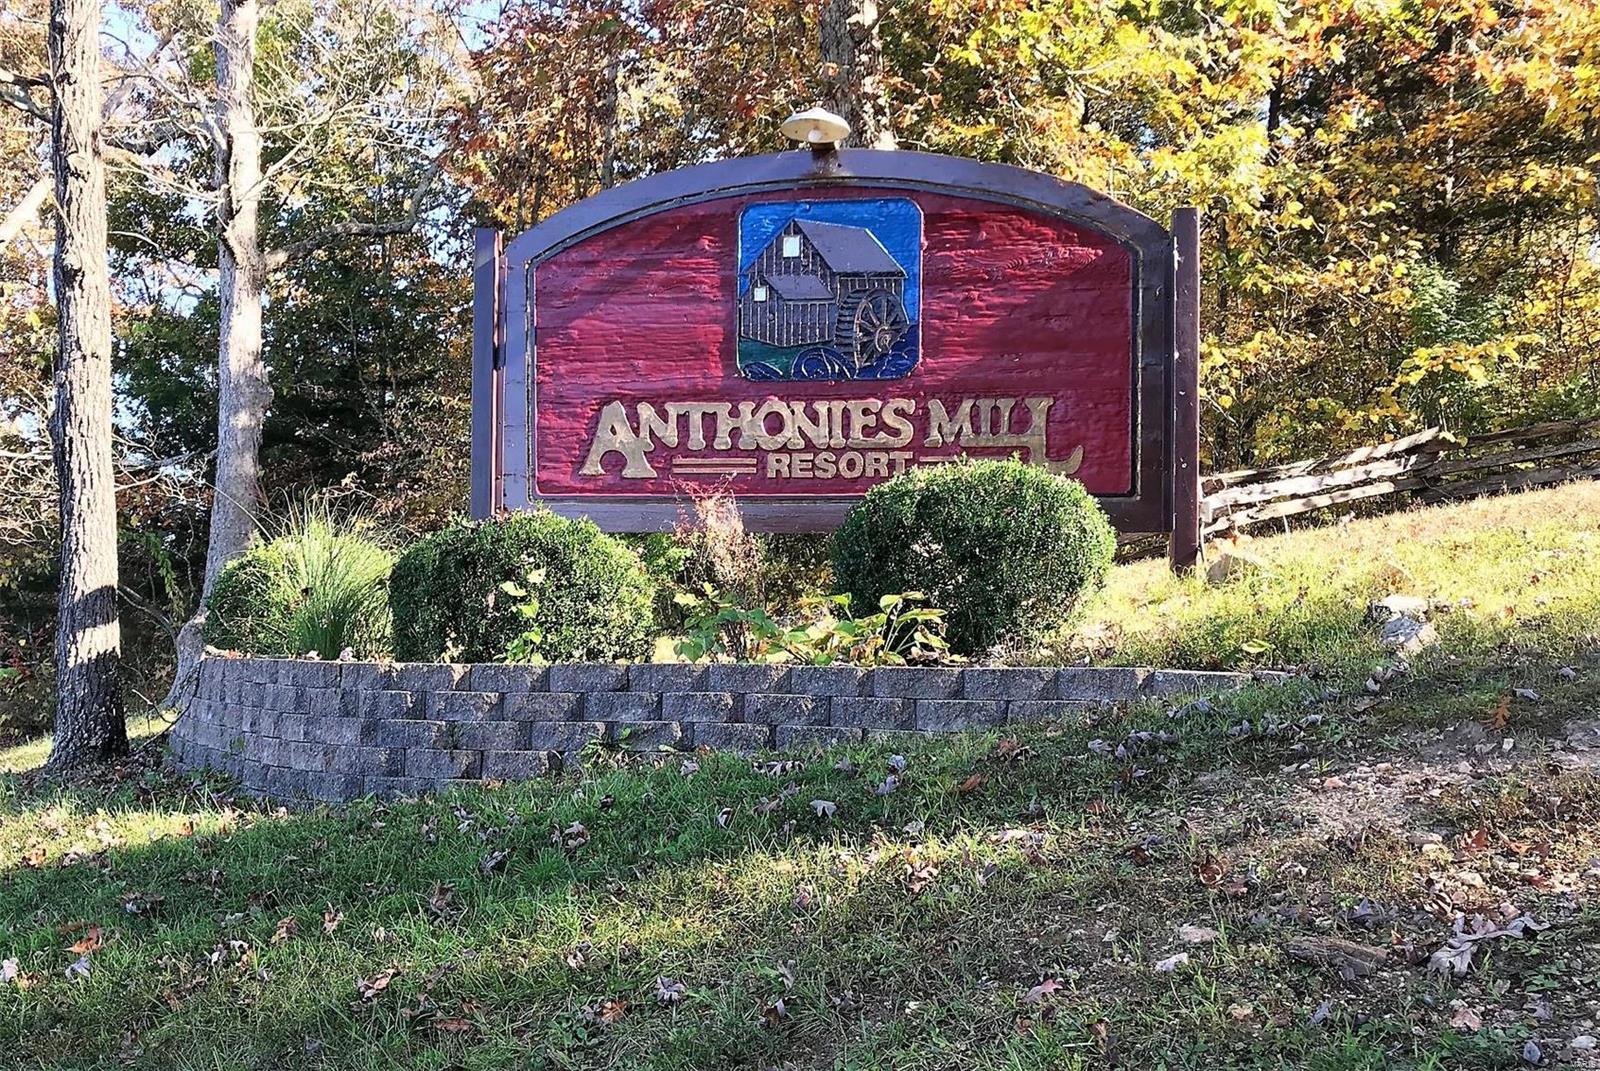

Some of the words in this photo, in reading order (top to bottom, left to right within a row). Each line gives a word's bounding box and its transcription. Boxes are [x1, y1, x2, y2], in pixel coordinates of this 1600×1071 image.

[578, 398, 916, 479] ANTHONIES
[923, 397, 1084, 475] MILL
[767, 451, 914, 479] RESORT
